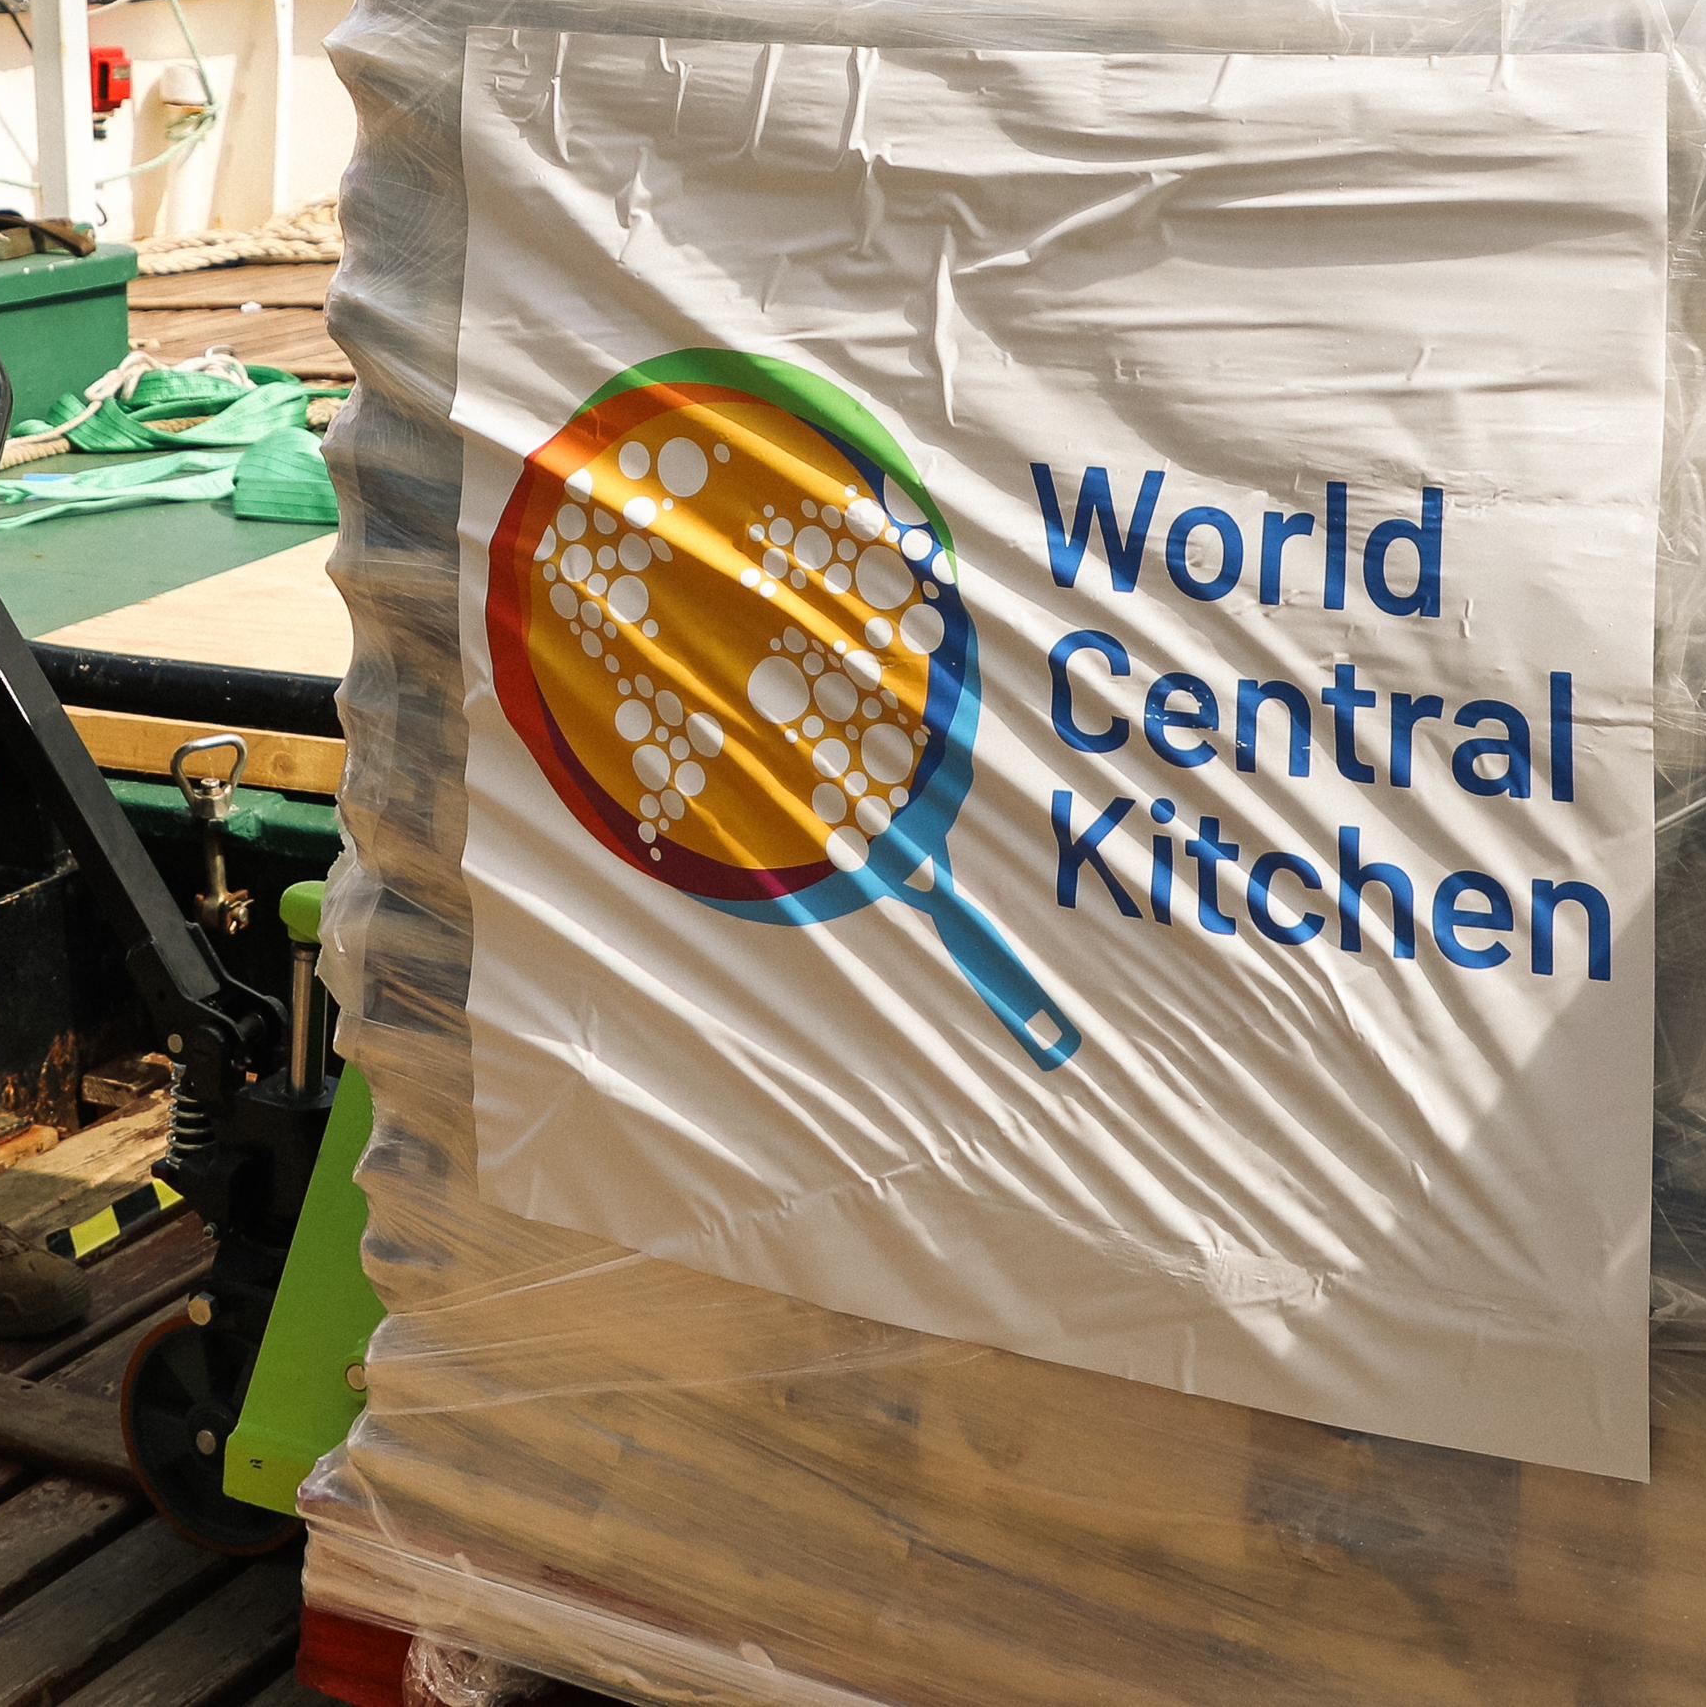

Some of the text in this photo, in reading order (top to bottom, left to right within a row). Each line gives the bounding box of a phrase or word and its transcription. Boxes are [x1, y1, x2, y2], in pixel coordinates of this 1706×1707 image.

[1030, 462, 1444, 618] World
[1047, 629, 1575, 803] Central
[1051, 789, 1612, 982] Kitchen
